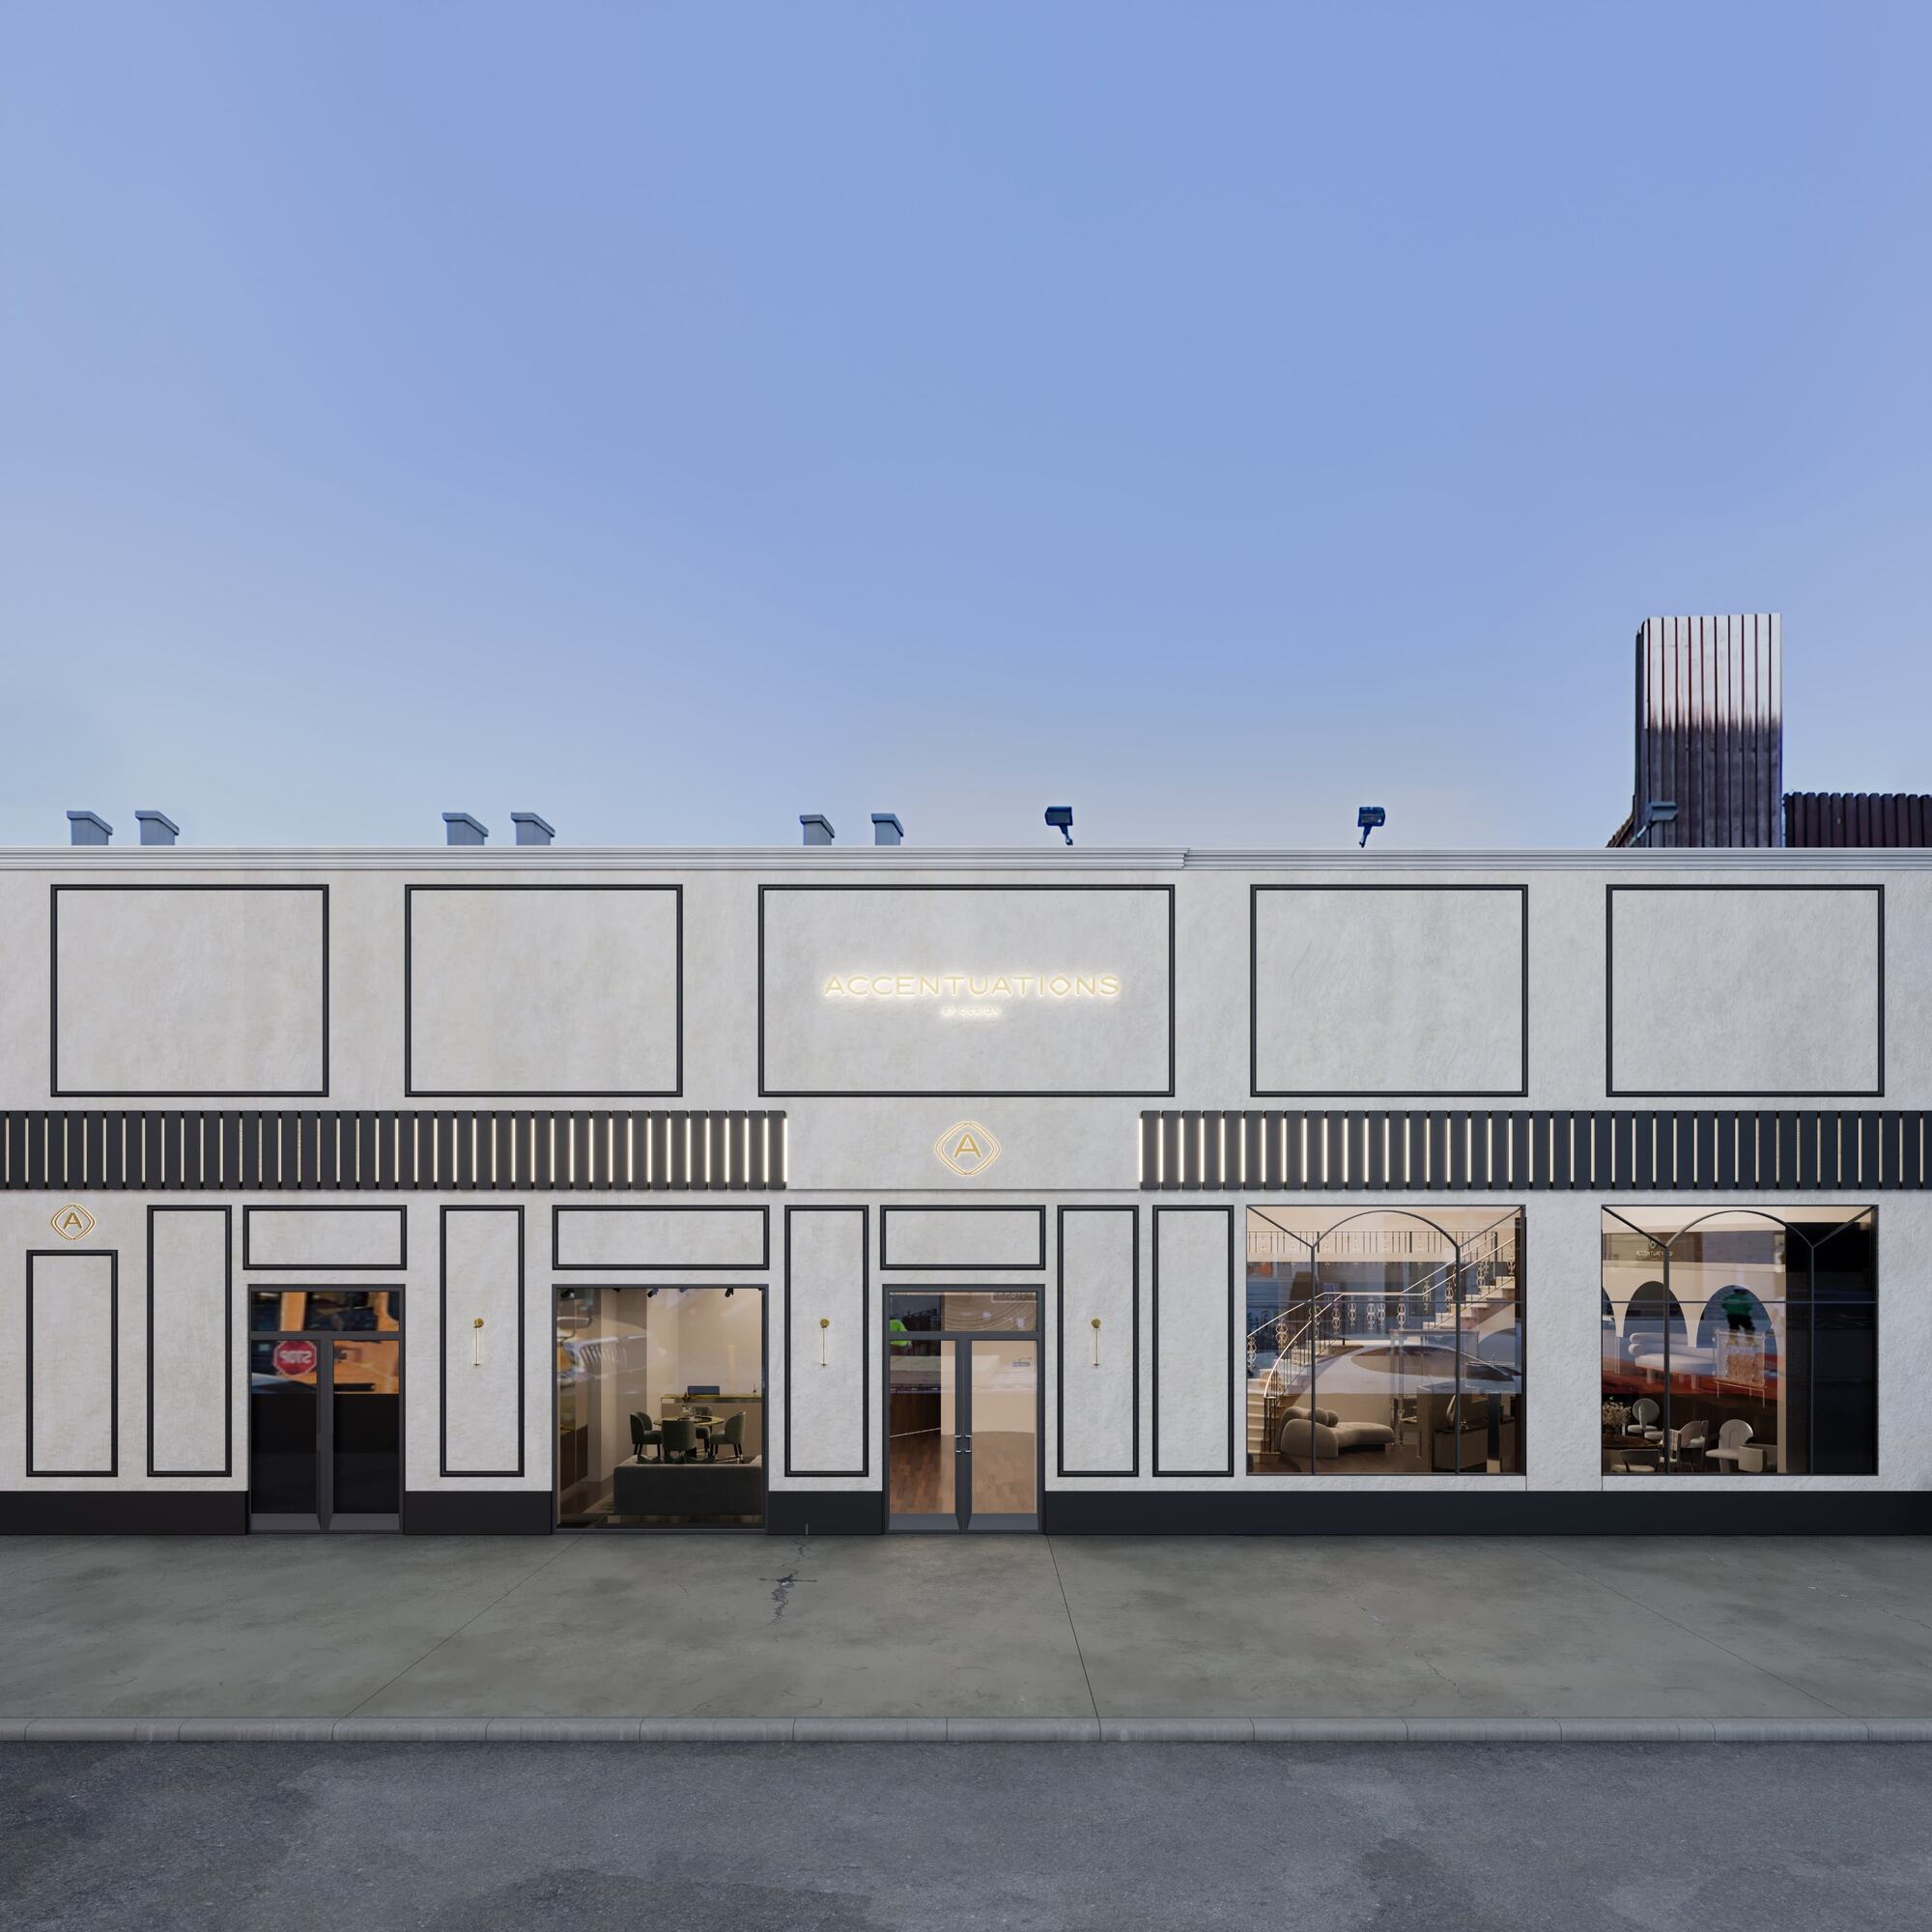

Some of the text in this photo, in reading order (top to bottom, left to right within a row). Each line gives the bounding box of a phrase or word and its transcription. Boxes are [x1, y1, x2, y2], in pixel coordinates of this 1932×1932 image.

[824, 975, 1121, 996] ACCENTUATIONS
[953, 1133, 981, 1159] A
[63, 1211, 83, 1229] A
